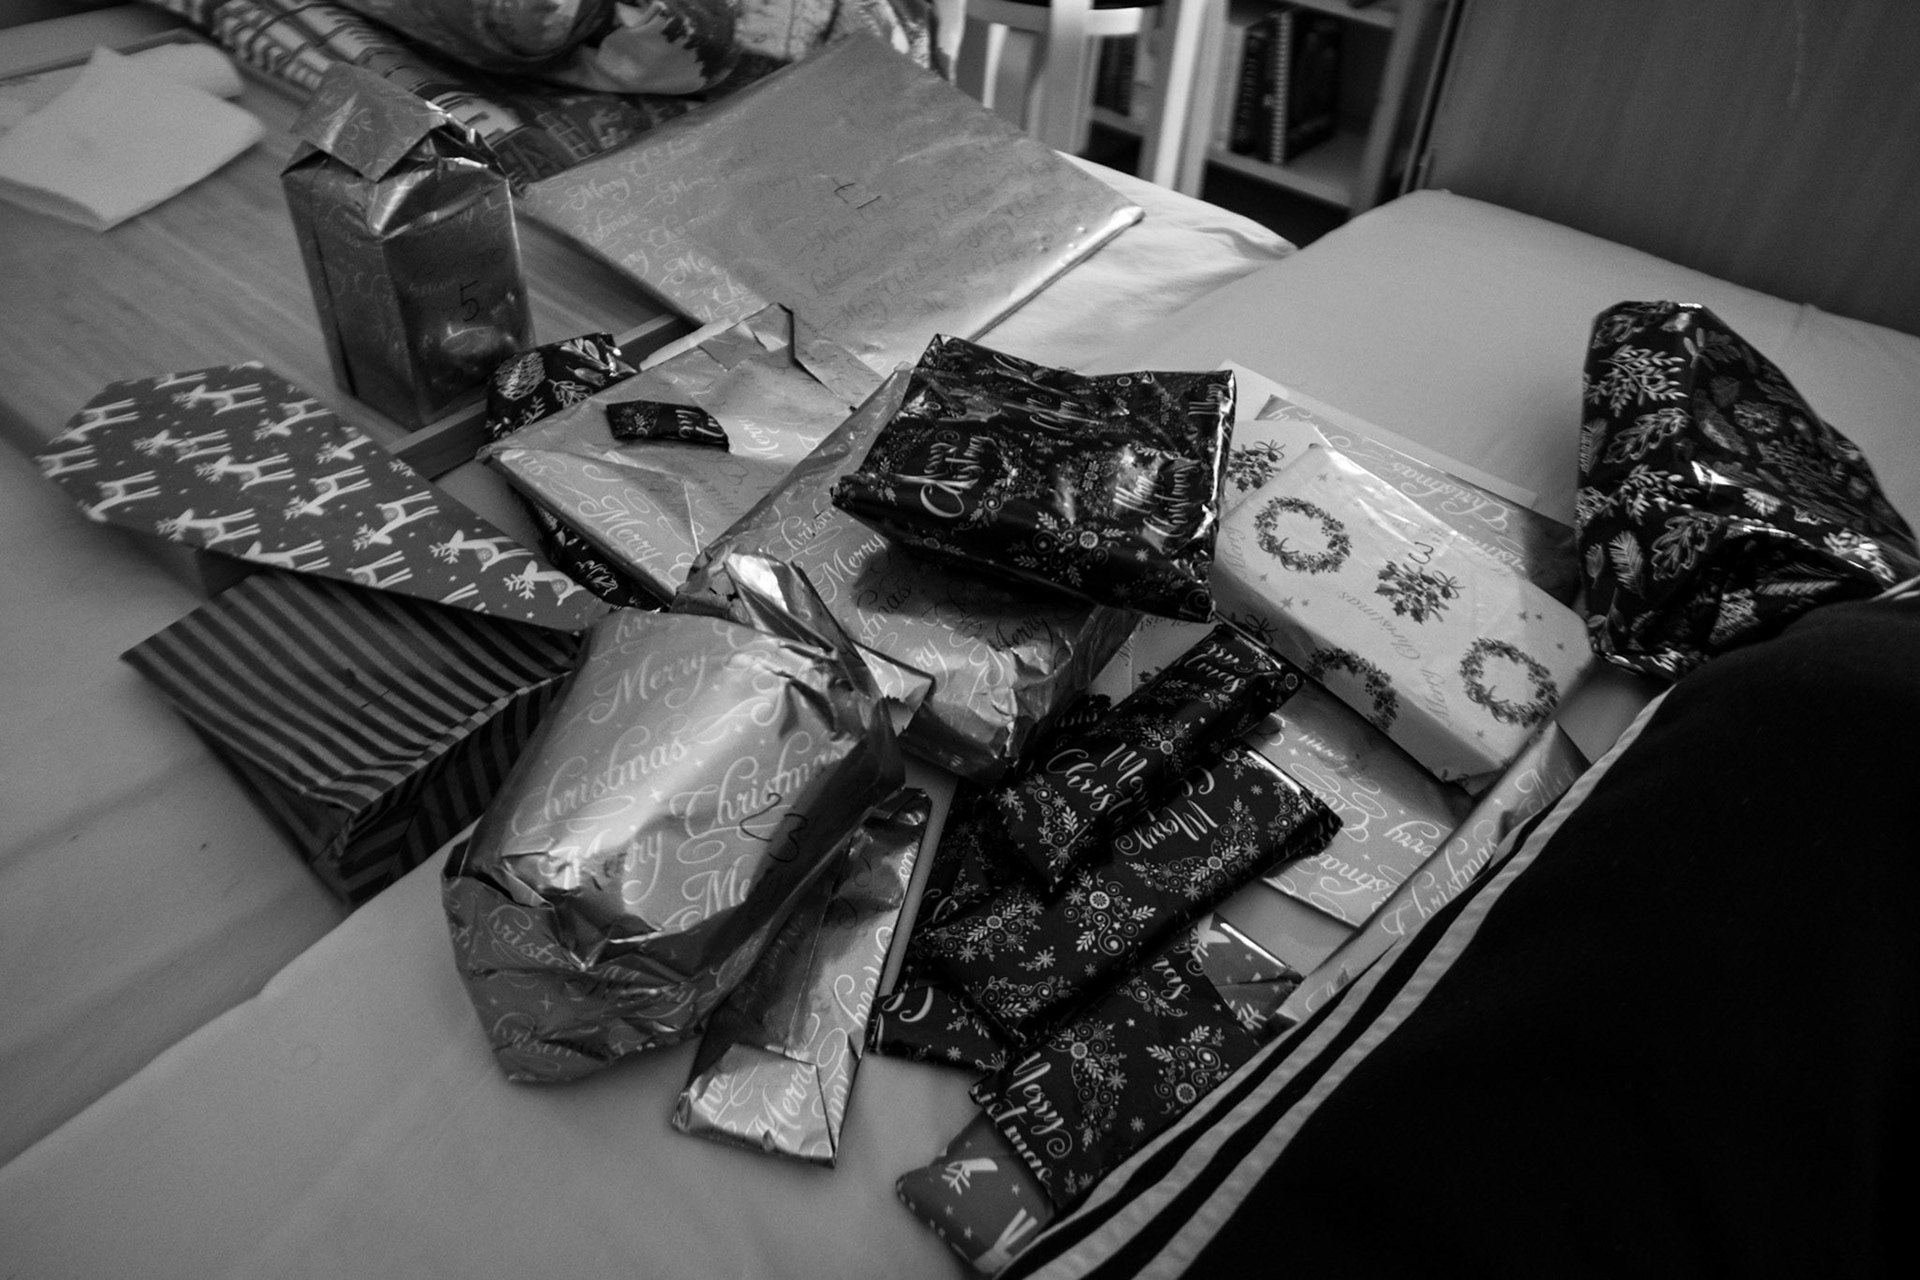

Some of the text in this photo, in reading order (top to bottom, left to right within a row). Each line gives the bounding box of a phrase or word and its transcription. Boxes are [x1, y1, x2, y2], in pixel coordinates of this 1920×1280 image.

[459, 281, 480, 322] 5
[578, 494, 663, 563] Merry
[1407, 541, 1435, 565] 3
[808, 530, 888, 605] Merry
[588, 645, 707, 725] Merry
[511, 724, 690, 838] Christmas
[1113, 798, 1220, 857] Merry
[1004, 1051, 1073, 1159] Merry
